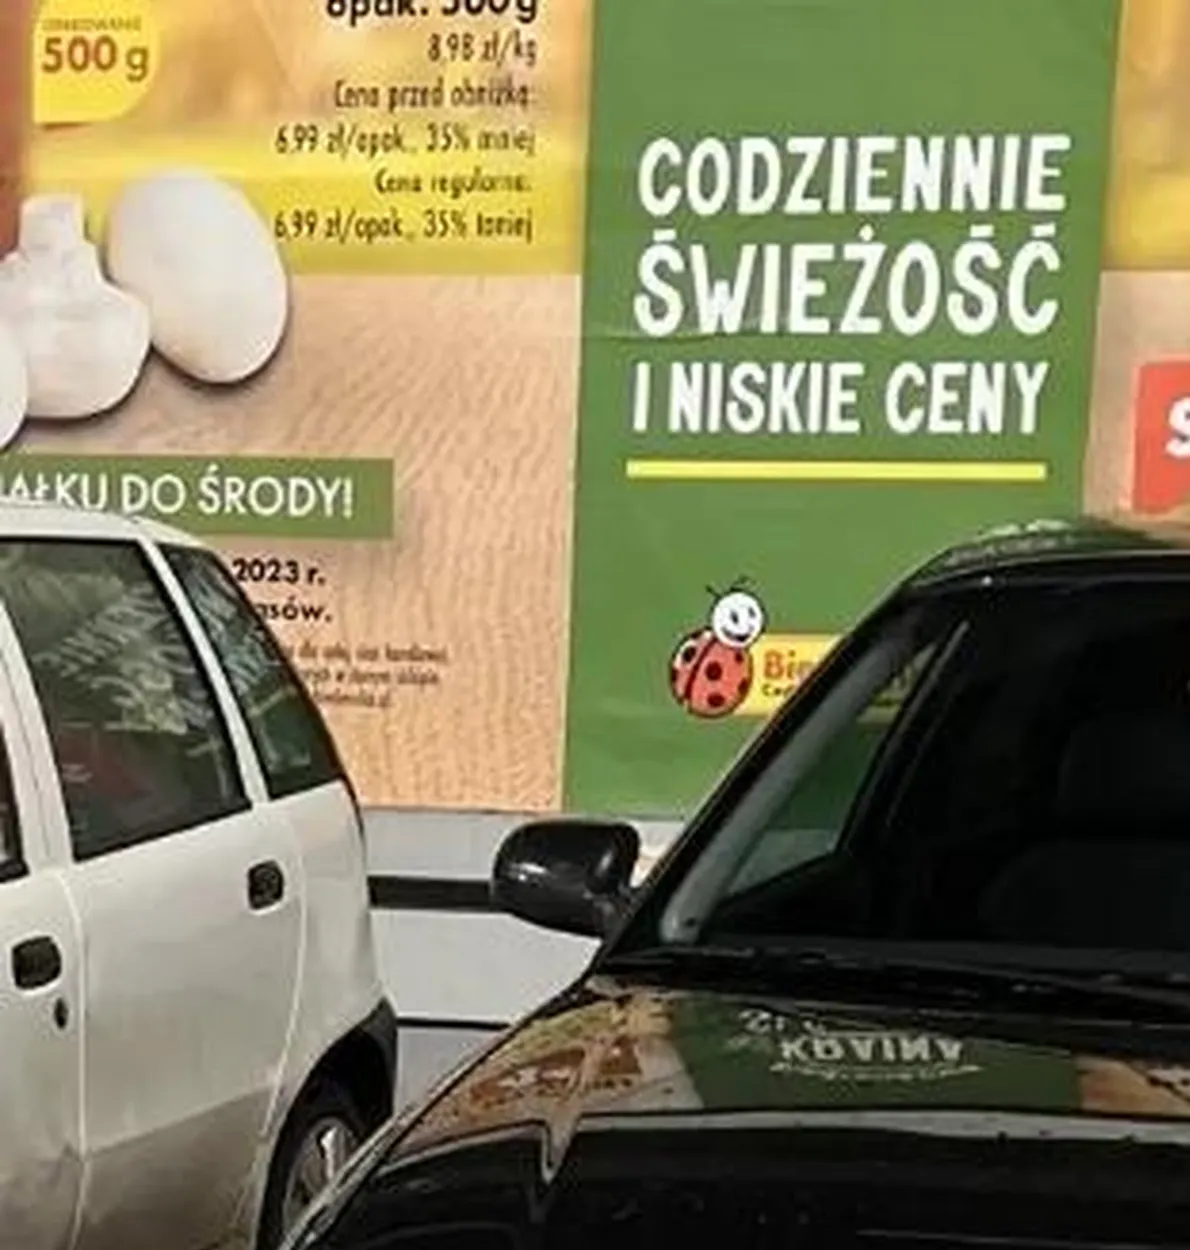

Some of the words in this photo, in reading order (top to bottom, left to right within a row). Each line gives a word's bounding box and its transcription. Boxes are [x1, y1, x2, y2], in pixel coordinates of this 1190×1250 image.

[42, 35, 117, 73] 500
[126, 46, 149, 82] g
[335, 79, 378, 108] Cena
[388, 76, 444, 113] przed
[427, 121, 470, 152] 35%
[374, 167, 421, 194] Cena
[639, 134, 1072, 217] CODZIENNIE
[424, 208, 468, 239] 35%
[633, 224, 1062, 337] ŚWIEŻOŚĆ
[632, 361, 652, 433] I
[669, 361, 864, 434] NISKIE
[885, 361, 1049, 434] CENY
[121, 474, 186, 514] DO
[198, 464, 354, 518] ŚRODY!
[232, 558, 299, 585] 2023
[306, 564, 326, 586] r.
